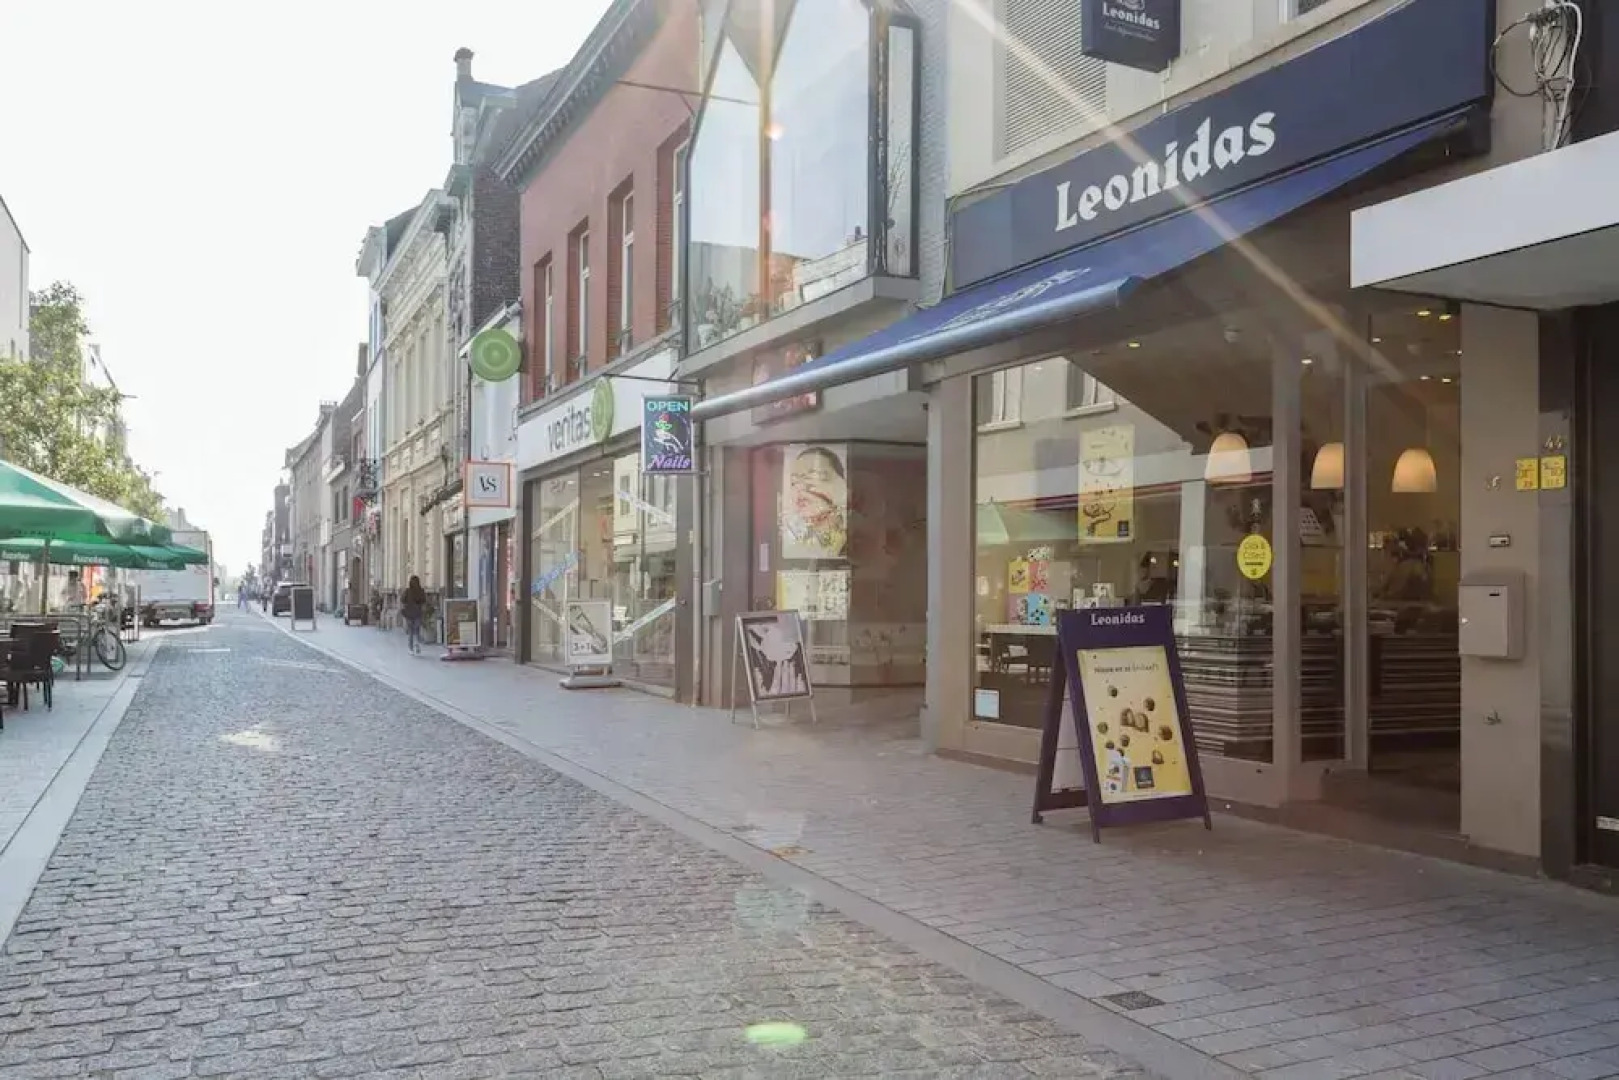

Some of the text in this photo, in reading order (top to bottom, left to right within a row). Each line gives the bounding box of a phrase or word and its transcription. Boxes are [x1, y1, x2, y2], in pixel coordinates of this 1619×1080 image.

[1102, 1, 1160, 30] Leonidas
[1055, 111, 1276, 232] Leonidas
[646, 400, 690, 413] OPEN
[546, 403, 592, 453] veritas
[647, 452, 692, 470] Nails
[479, 475, 497, 492] VS
[1090, 611, 1146, 626] Leonidas
